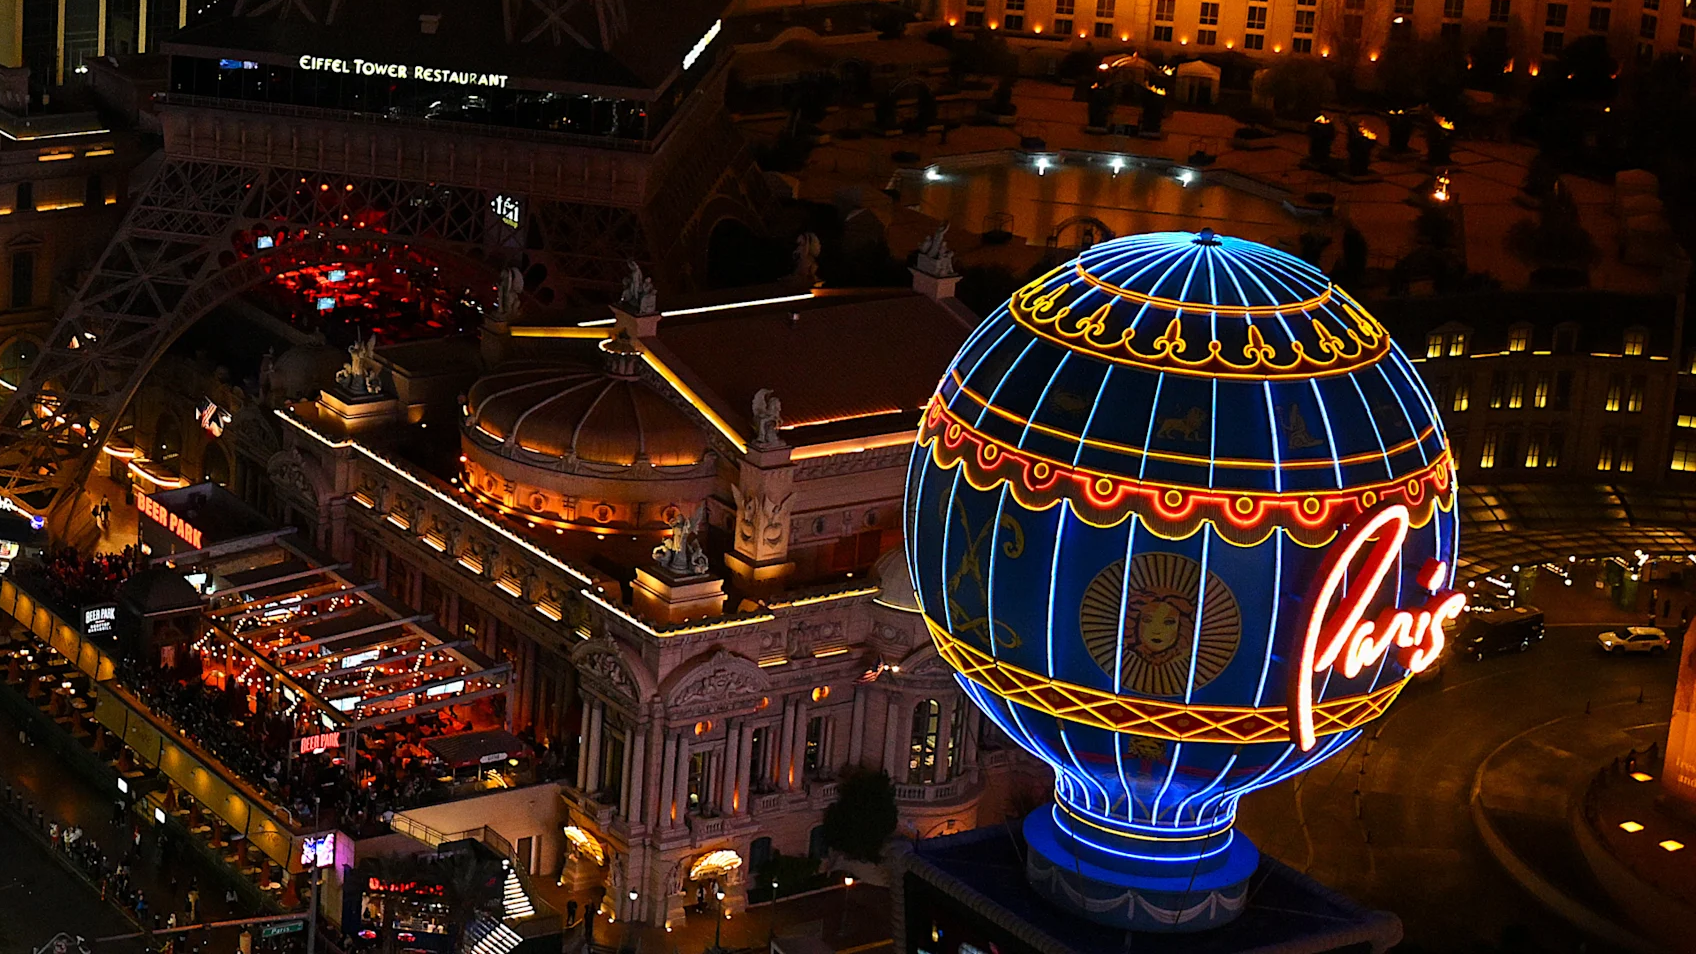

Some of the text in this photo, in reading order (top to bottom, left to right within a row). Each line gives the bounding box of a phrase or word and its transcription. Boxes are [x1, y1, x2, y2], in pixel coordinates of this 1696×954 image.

[299, 55, 508, 88] EIFFEL TOWER RESTAURANT
[137, 492, 203, 550] BEER PARK
[85, 607, 115, 624] BEER PARK
[1298, 505, 1466, 752] Paris
[300, 732, 340, 754] BEER PARK
[271, 926, 290, 934] Paris
